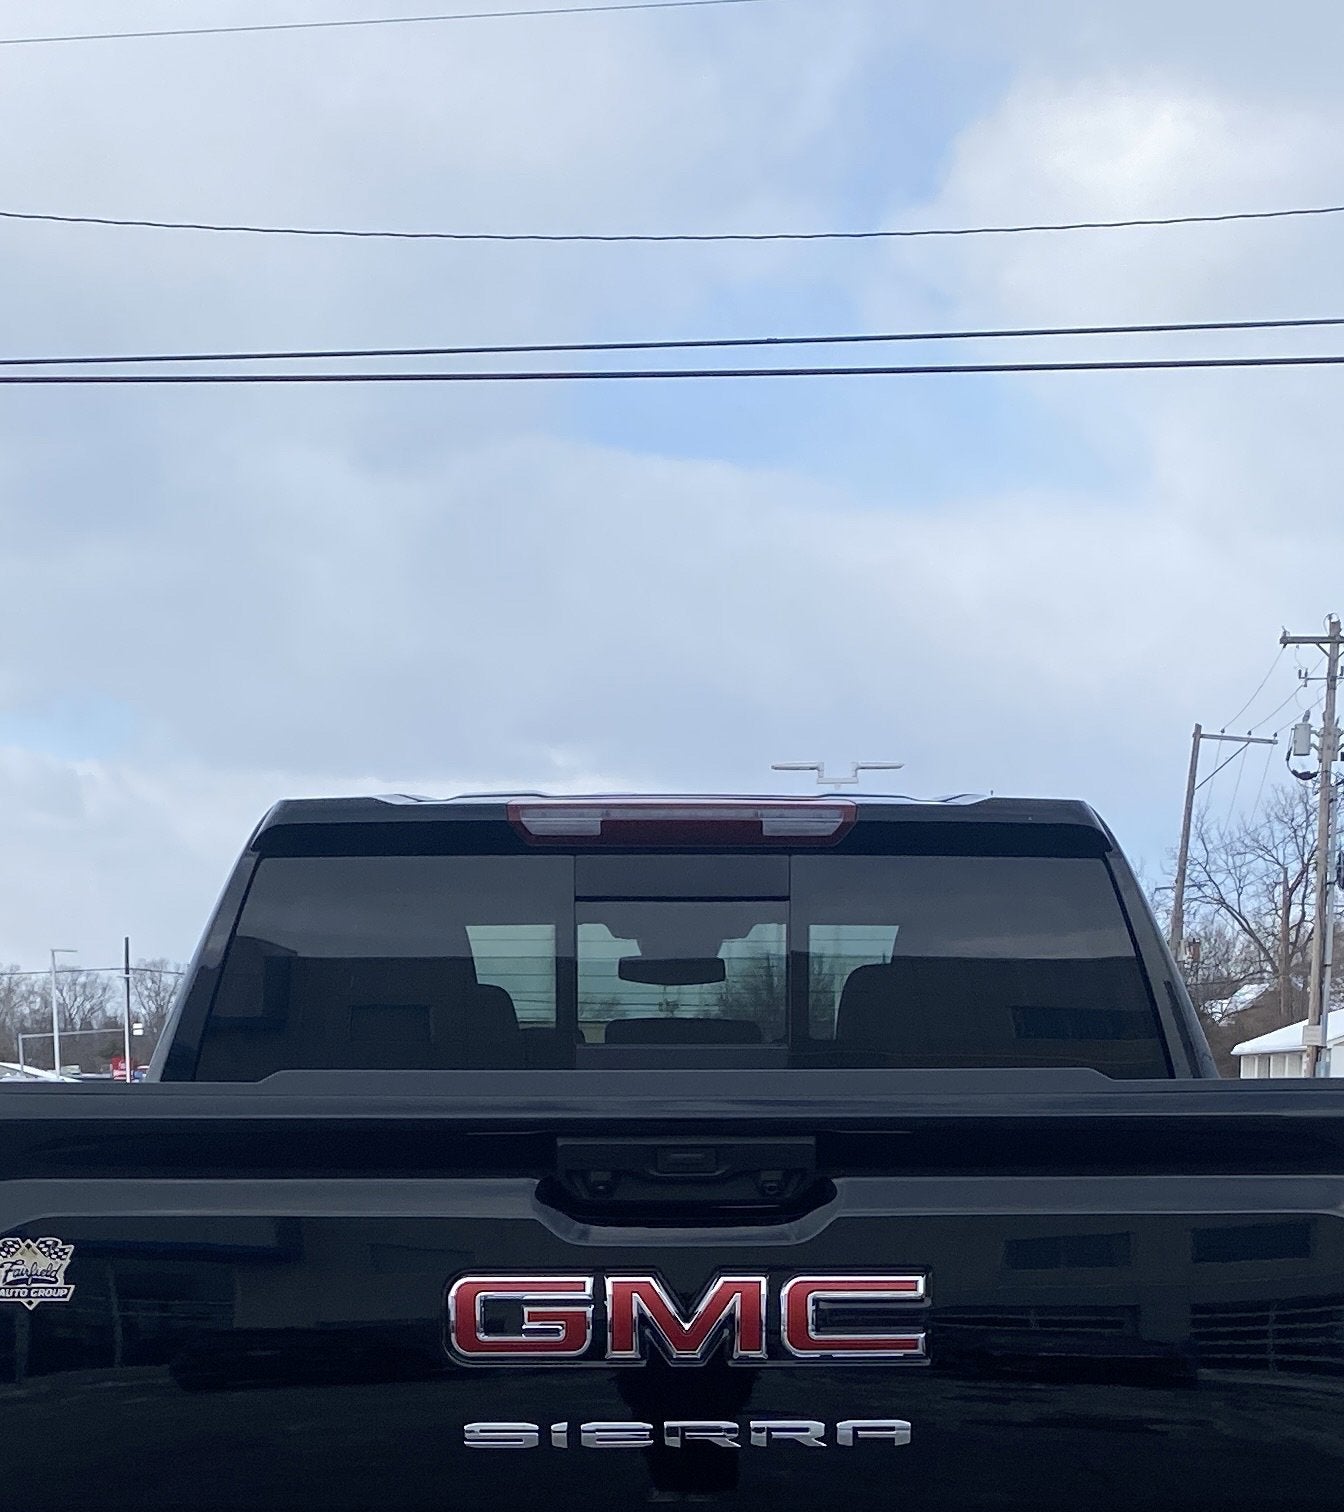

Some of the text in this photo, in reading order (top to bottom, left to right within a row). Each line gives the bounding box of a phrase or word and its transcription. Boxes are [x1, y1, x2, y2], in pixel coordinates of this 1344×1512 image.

[30, 1288, 68, 1298] GROUP
[446, 1275, 929, 1361] GMC
[463, 1419, 912, 1449] SIERRA
